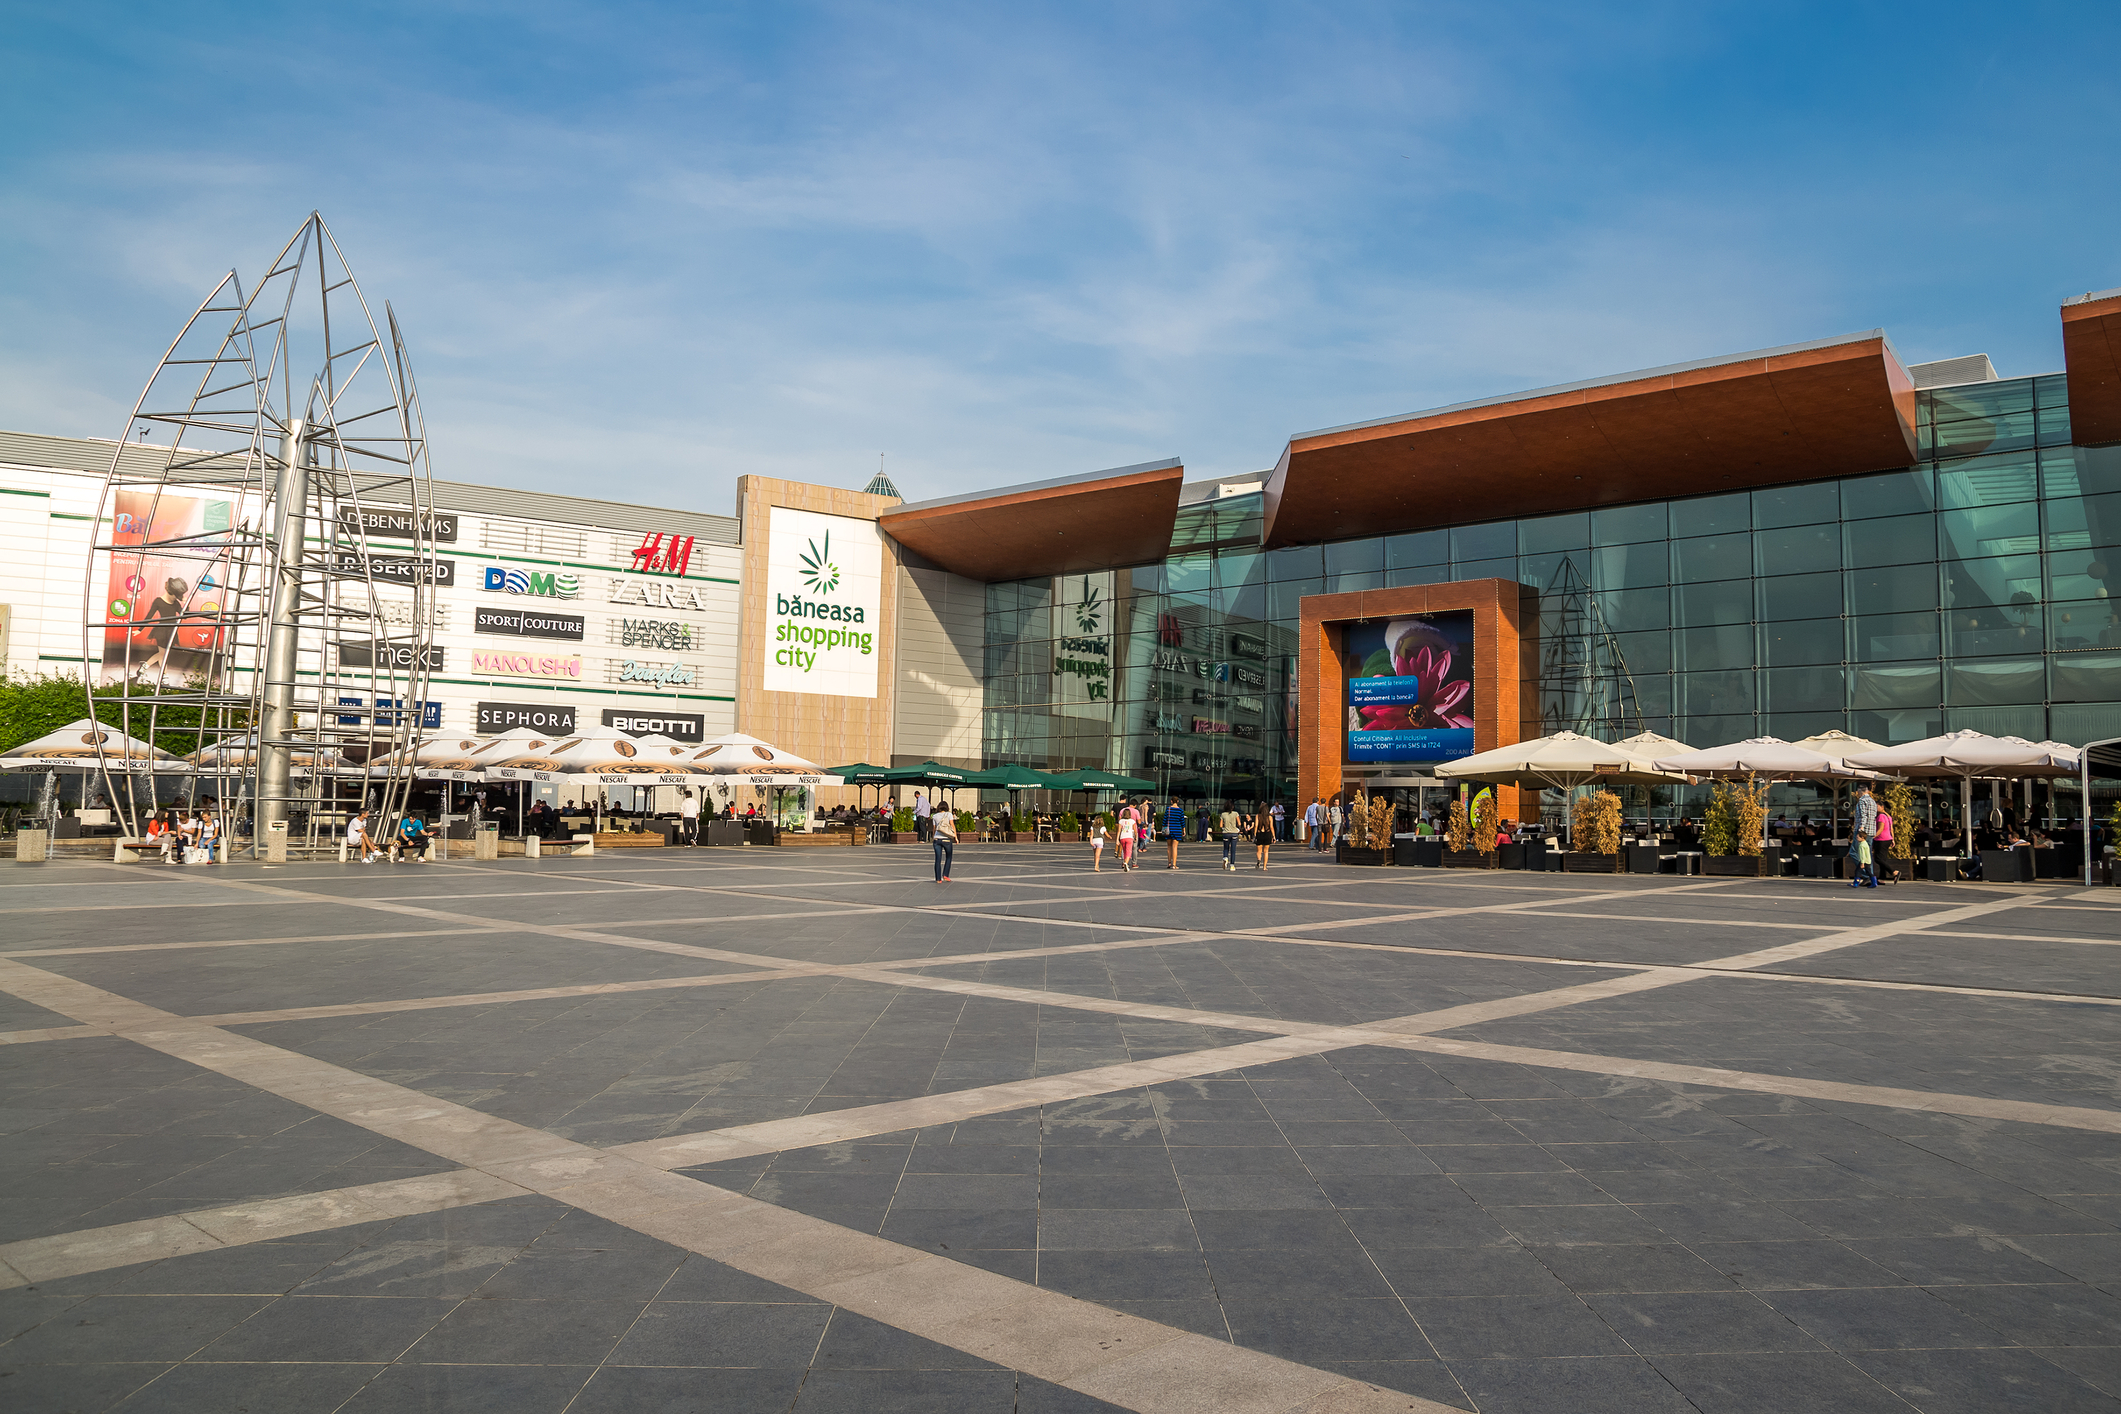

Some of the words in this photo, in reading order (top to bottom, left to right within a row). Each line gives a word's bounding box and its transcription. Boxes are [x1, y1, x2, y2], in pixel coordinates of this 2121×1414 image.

[632, 531, 694, 576] H&M
[344, 556, 449, 580] RSERVED
[484, 566, 579, 600] DOMO
[610, 579, 706, 612] ZARA
[777, 593, 864, 623] băneasa
[478, 614, 520, 628] SPORT
[524, 618, 582, 633] COUTURE
[623, 618, 680, 636] MARKS
[681, 623, 691, 637] &
[622, 632, 692, 651] SPENCER
[776, 619, 872, 654] shopping
[474, 653, 568, 676] MANOUSH
[776, 645, 816, 673] city
[481, 709, 572, 727] SEPHORA
[613, 717, 696, 734] BIGOTTI
[118, 759, 150, 769] NSCAF
